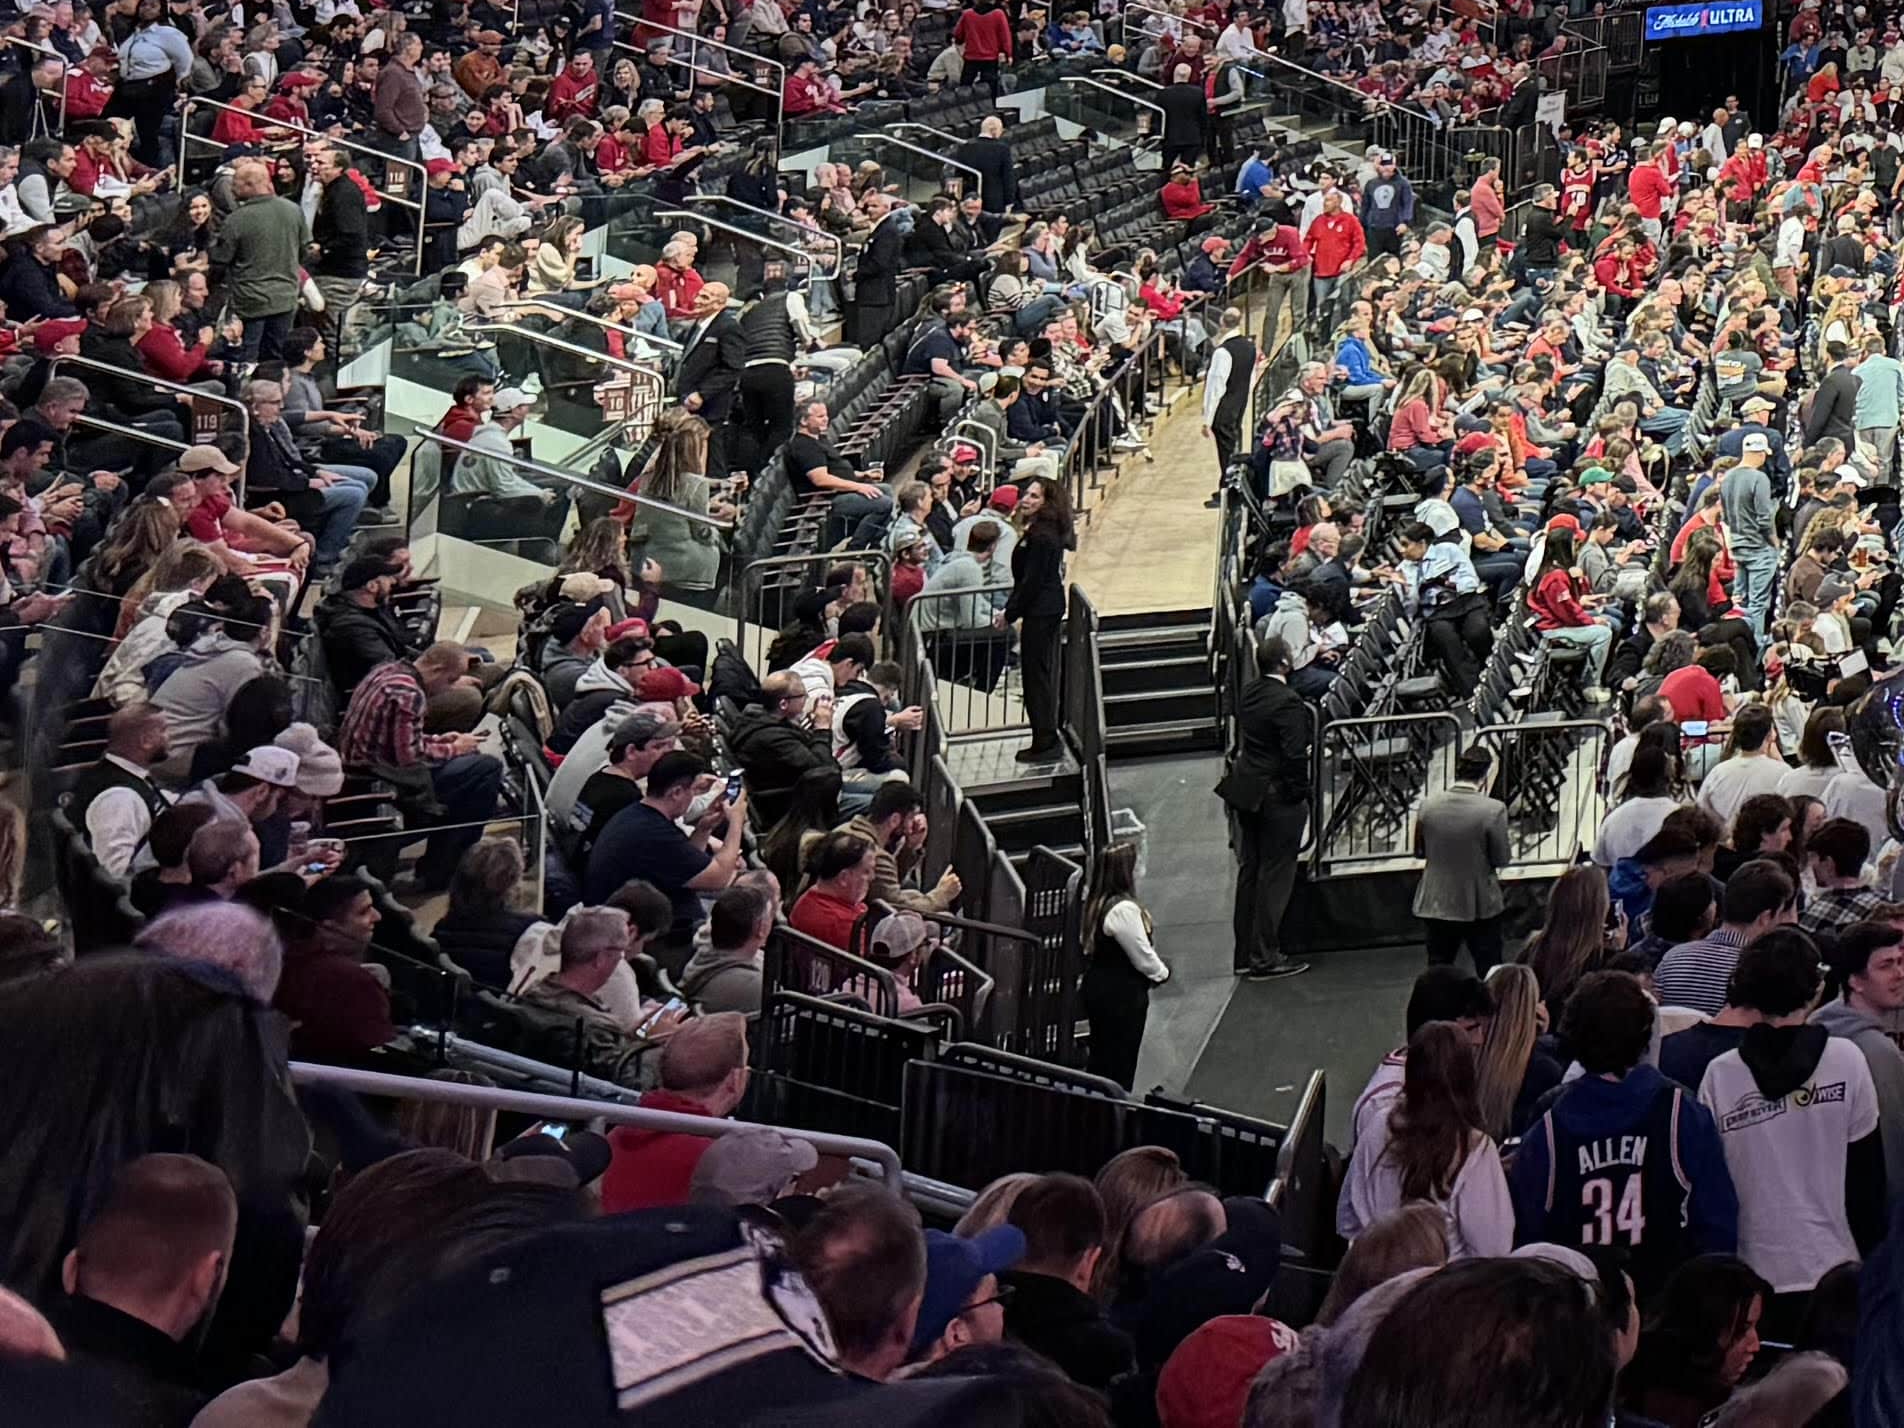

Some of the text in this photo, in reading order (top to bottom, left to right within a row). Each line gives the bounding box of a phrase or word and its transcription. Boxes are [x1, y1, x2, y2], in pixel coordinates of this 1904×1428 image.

[1710, 7, 1754, 25] ULTRA
[197, 414, 218, 430] 119
[1817, 1083, 1844, 1102] WISE
[1578, 1136, 1648, 1177] ALLEN
[1581, 1172, 1646, 1246] 34
